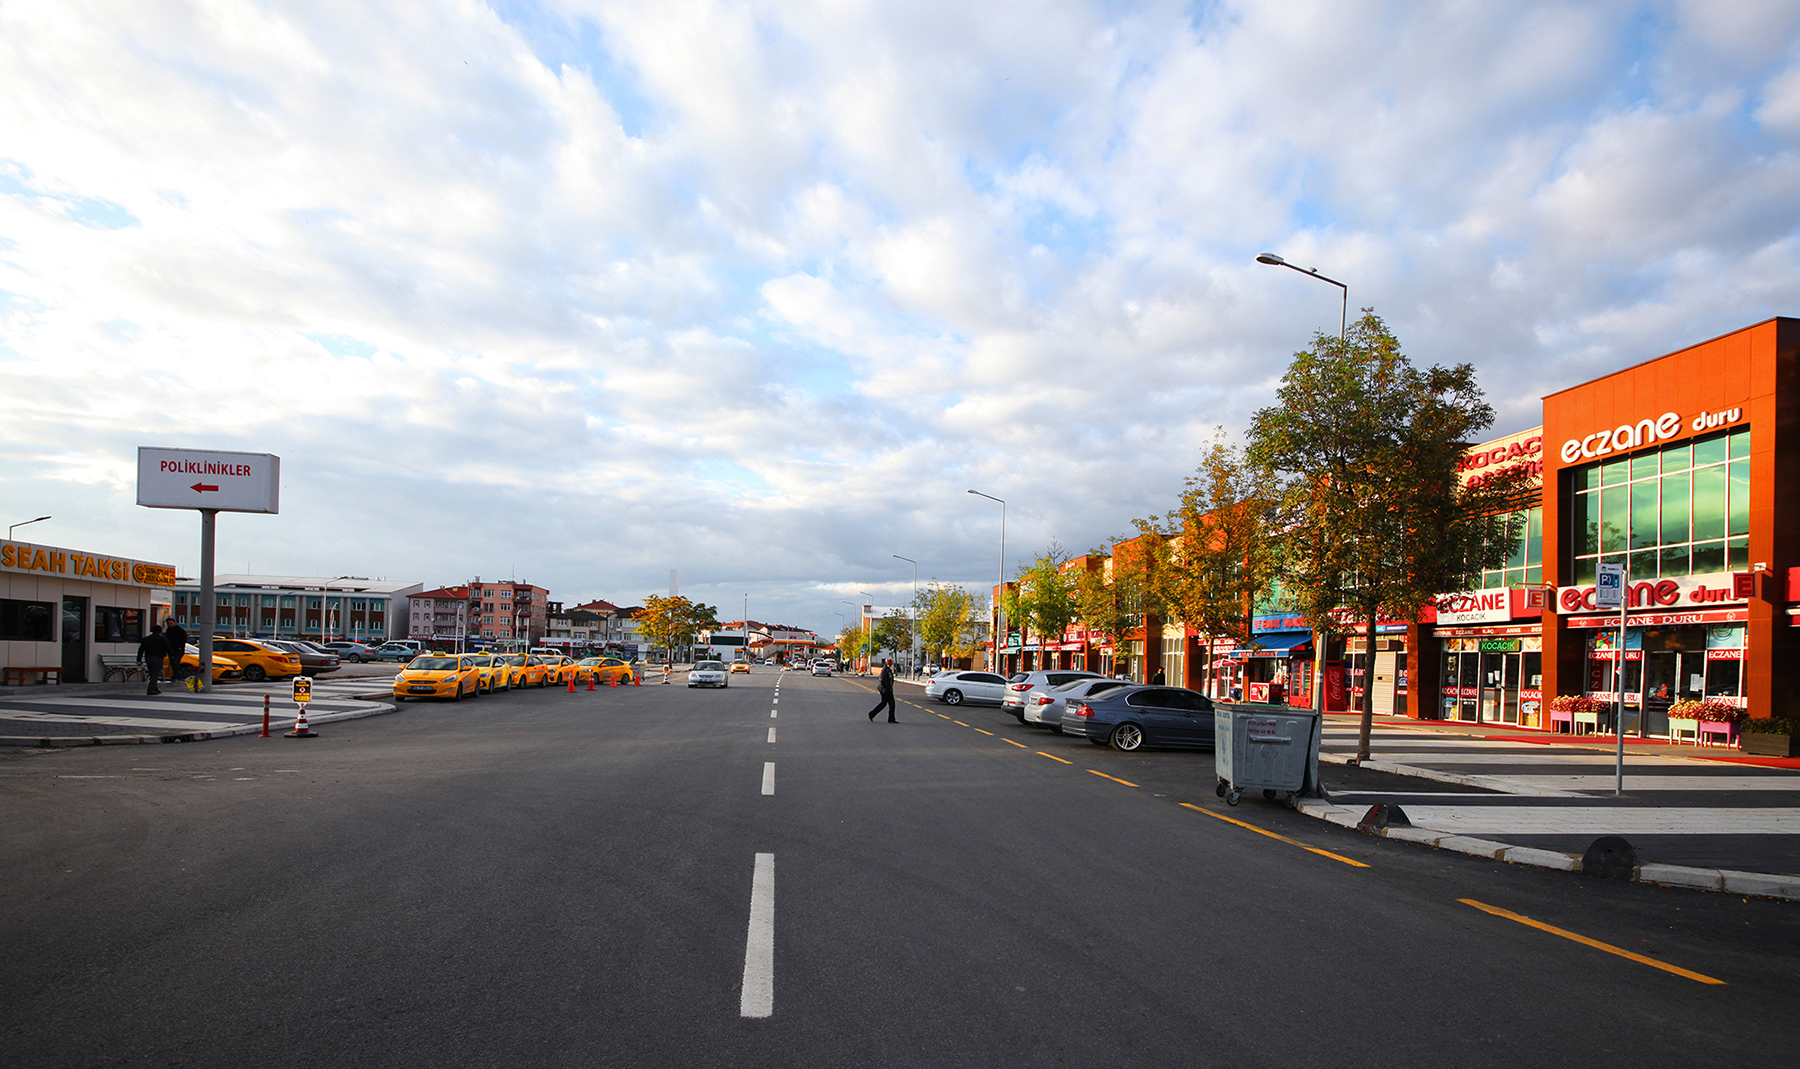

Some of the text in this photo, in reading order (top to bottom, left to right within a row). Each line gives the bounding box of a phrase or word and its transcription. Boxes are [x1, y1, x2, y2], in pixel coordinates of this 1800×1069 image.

[1561, 408, 1742, 463] eczane duru
[1457, 434, 1543, 473] KOCAC
[161, 459, 250, 476] POLİKLİNİKLER
[2, 545, 66, 573] SEAH
[1437, 593, 1505, 614] ECZANE
[1560, 580, 1680, 611] ecne
[1604, 614, 1704, 627] ECANE DURU
[1481, 641, 1516, 651] KOCACIK
[1588, 651, 1613, 659] ECZANE
[1708, 650, 1741, 659] ECZANE
